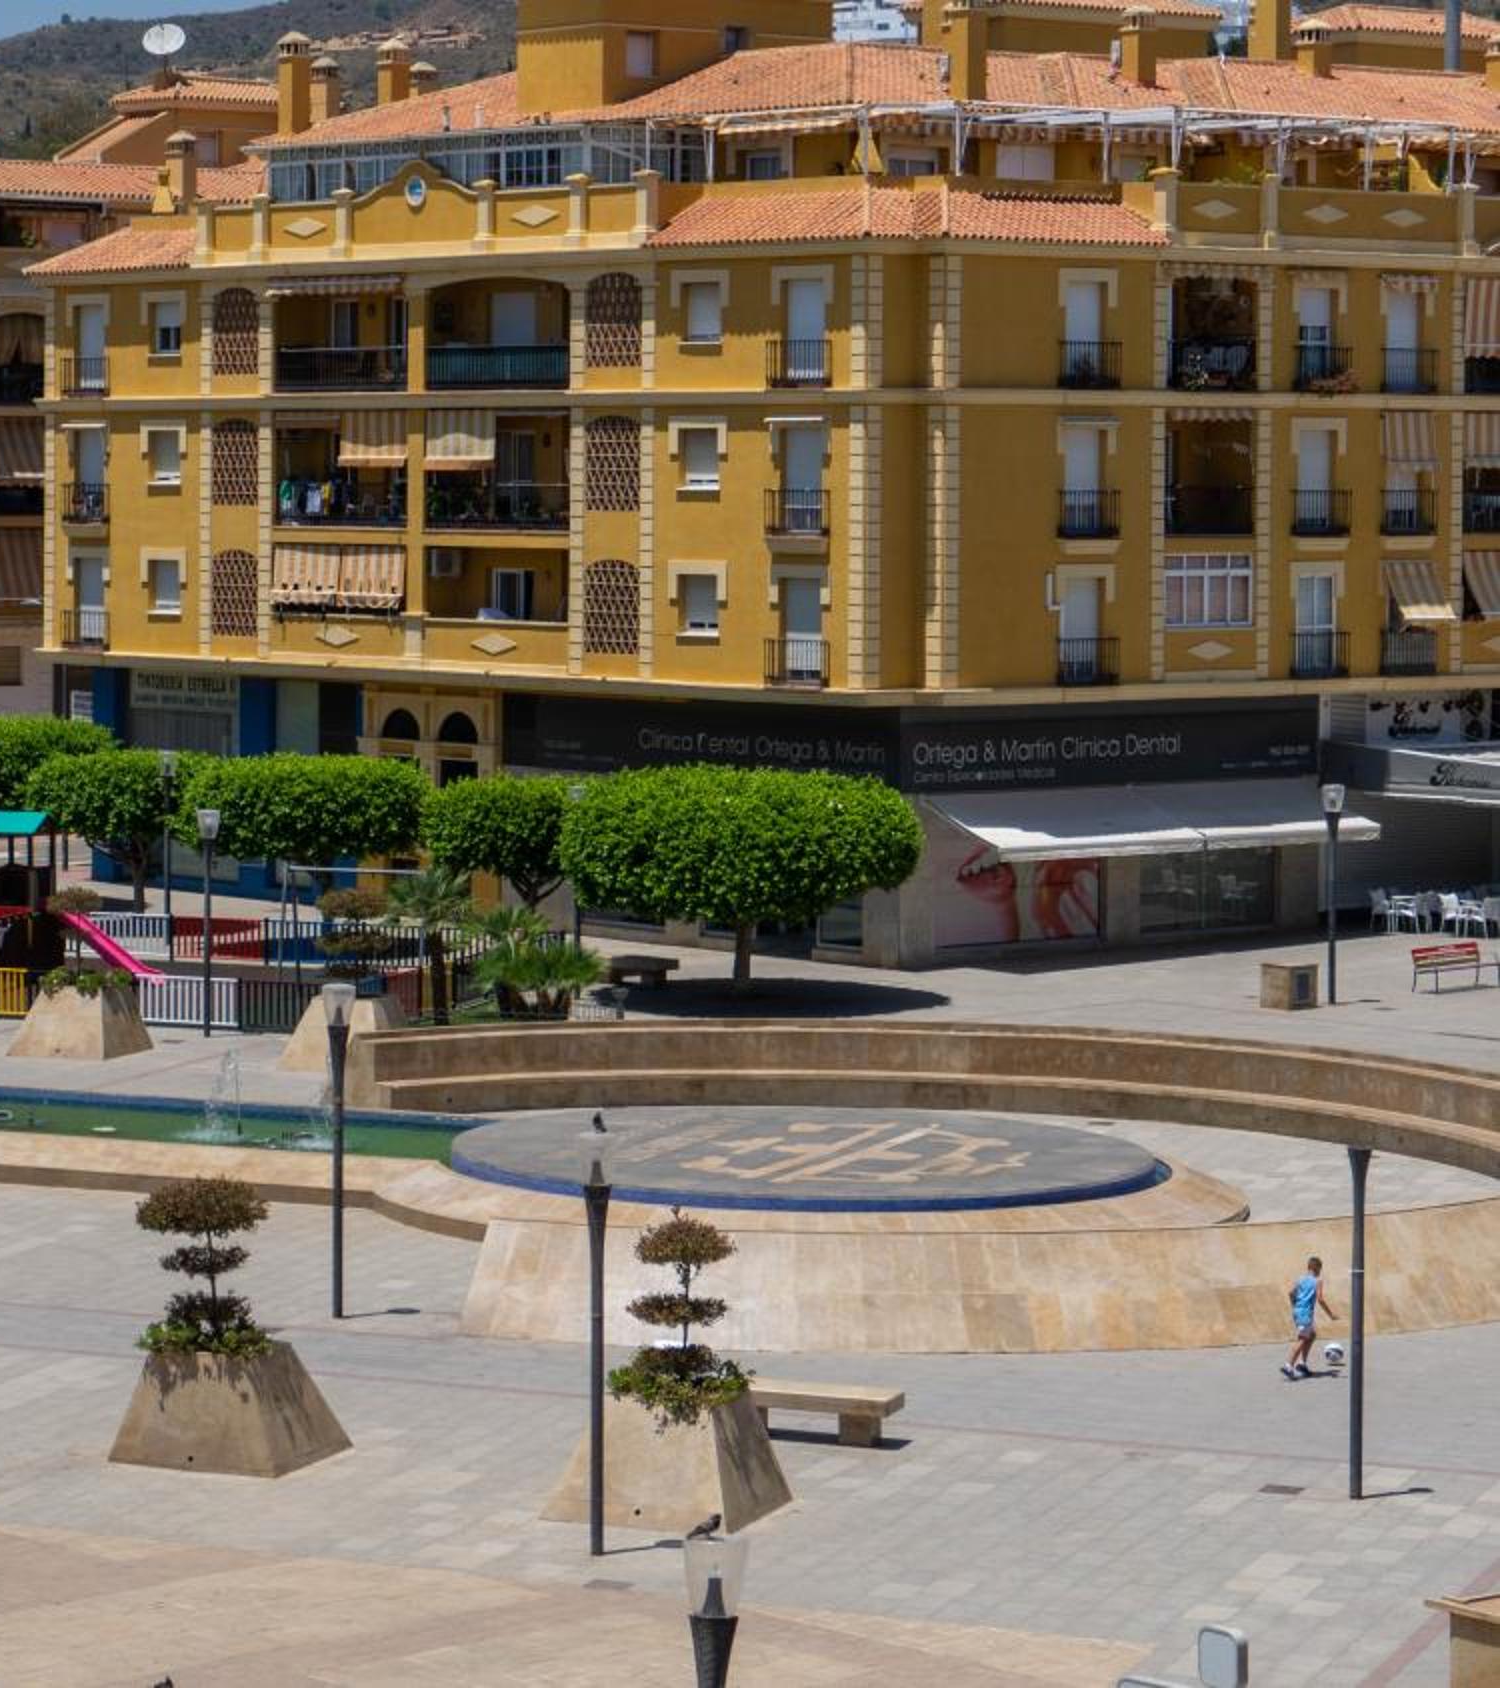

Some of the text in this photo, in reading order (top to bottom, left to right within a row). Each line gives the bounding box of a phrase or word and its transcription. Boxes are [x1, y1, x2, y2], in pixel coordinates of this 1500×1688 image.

[755, 735, 813, 763] Ortega
[818, 739, 831, 762] &
[912, 741, 978, 768] Ortega
[983, 739, 996, 763] &
[1125, 733, 1181, 756] Dental
